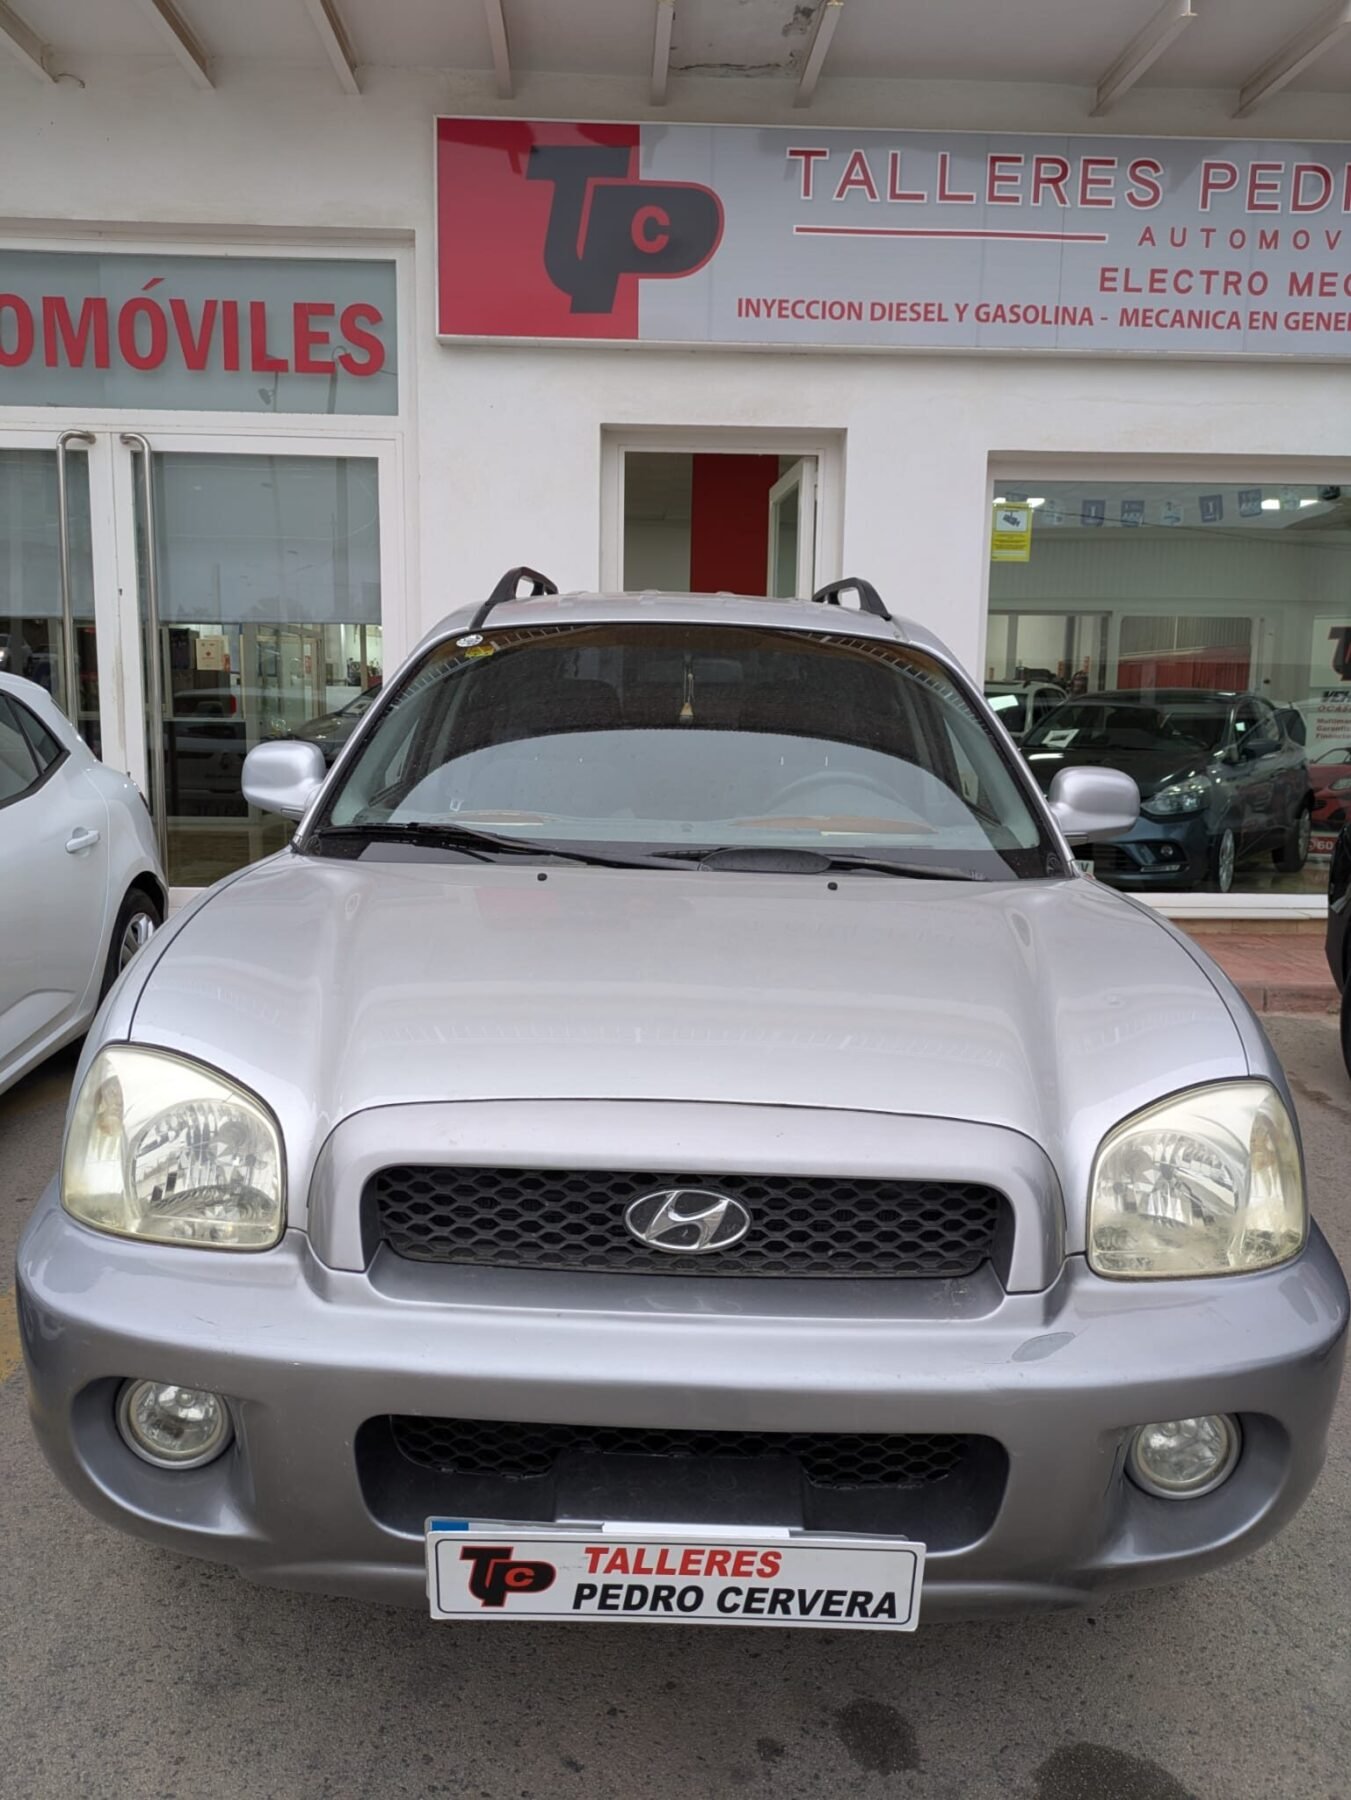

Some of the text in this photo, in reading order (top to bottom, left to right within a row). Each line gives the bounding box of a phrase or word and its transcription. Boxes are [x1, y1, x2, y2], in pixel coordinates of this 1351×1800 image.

[787, 147, 1351, 215] TALLERES PED
[1138, 225, 1343, 251] AUTOMOV
[1100, 266, 1269, 297] ELECTRO
[0, 277, 386, 377] OMÓVILES
[736, 297, 864, 322] INYECCION
[869, 301, 949, 323] DIESEL
[954, 302, 970, 323] Y
[974, 303, 1094, 326] GASOLINA
[1118, 307, 1242, 331] MECANICA
[1247, 310, 1278, 331] EN
[1284, 311, 1351, 332] GENE
[585, 1546, 783, 1579] TALLERES
[572, 1583, 897, 1620] PEDRO CERVERA
